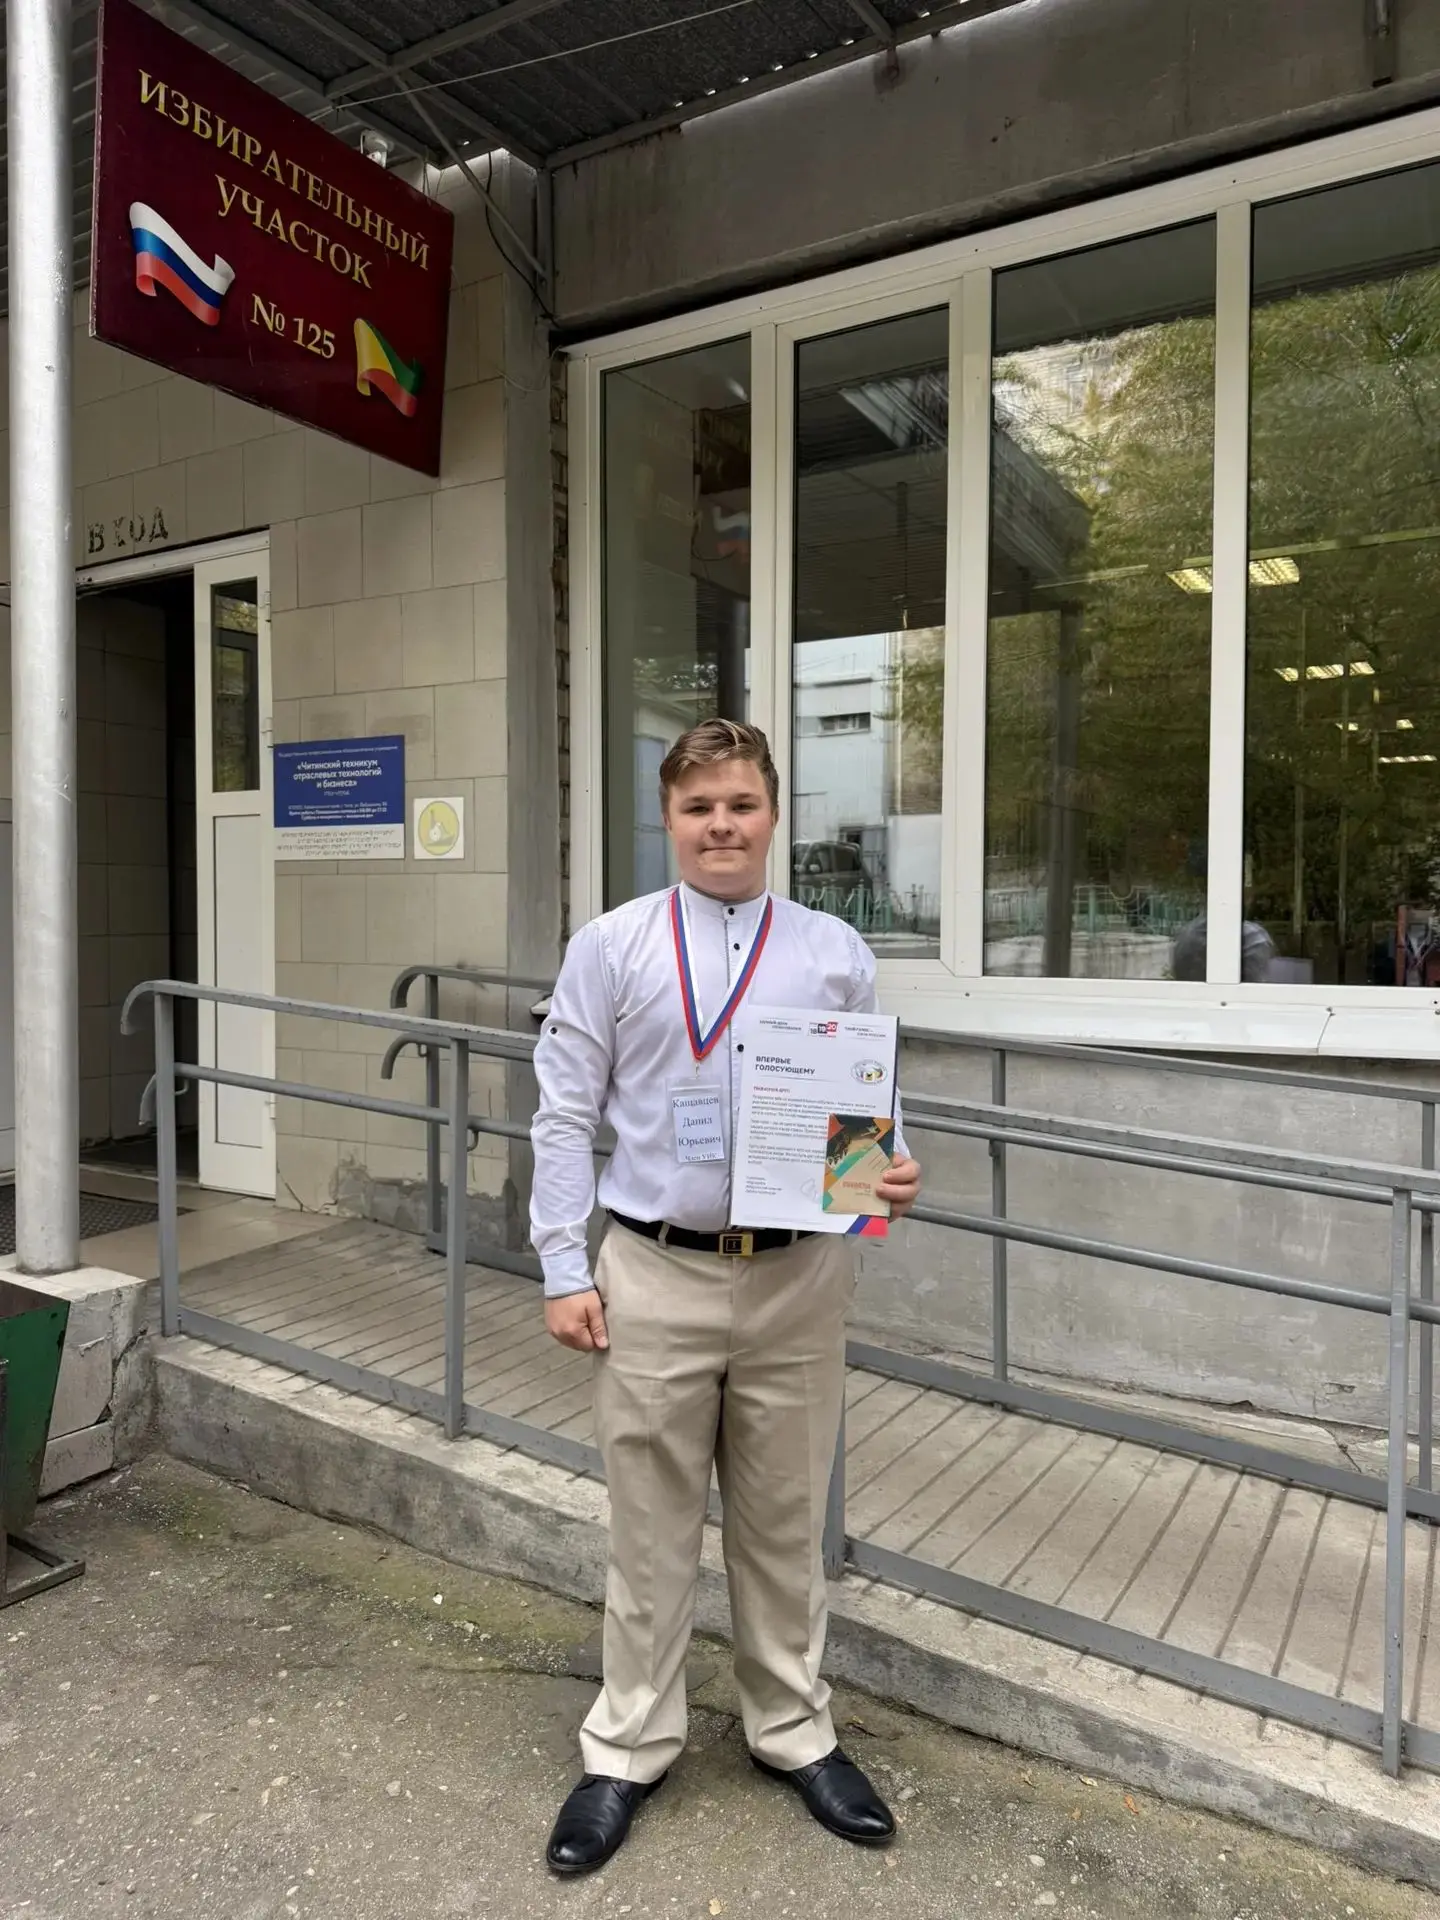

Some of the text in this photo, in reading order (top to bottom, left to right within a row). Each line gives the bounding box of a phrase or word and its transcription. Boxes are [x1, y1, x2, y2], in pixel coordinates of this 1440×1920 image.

[138, 68, 430, 271] ИЗБИРАТЕЛЬНЫЙ
[214, 173, 372, 290] УЧАСТОК
[251, 293, 336, 359] № 125
[342, 758, 378, 770] техникум
[338, 767, 382, 778] технологий
[755, 1055, 792, 1065] ВПЕРВЫЕ
[755, 1063, 816, 1075] ГОЛОСУЮЩЕМУ
[678, 1136, 721, 1148] Юрьевич
